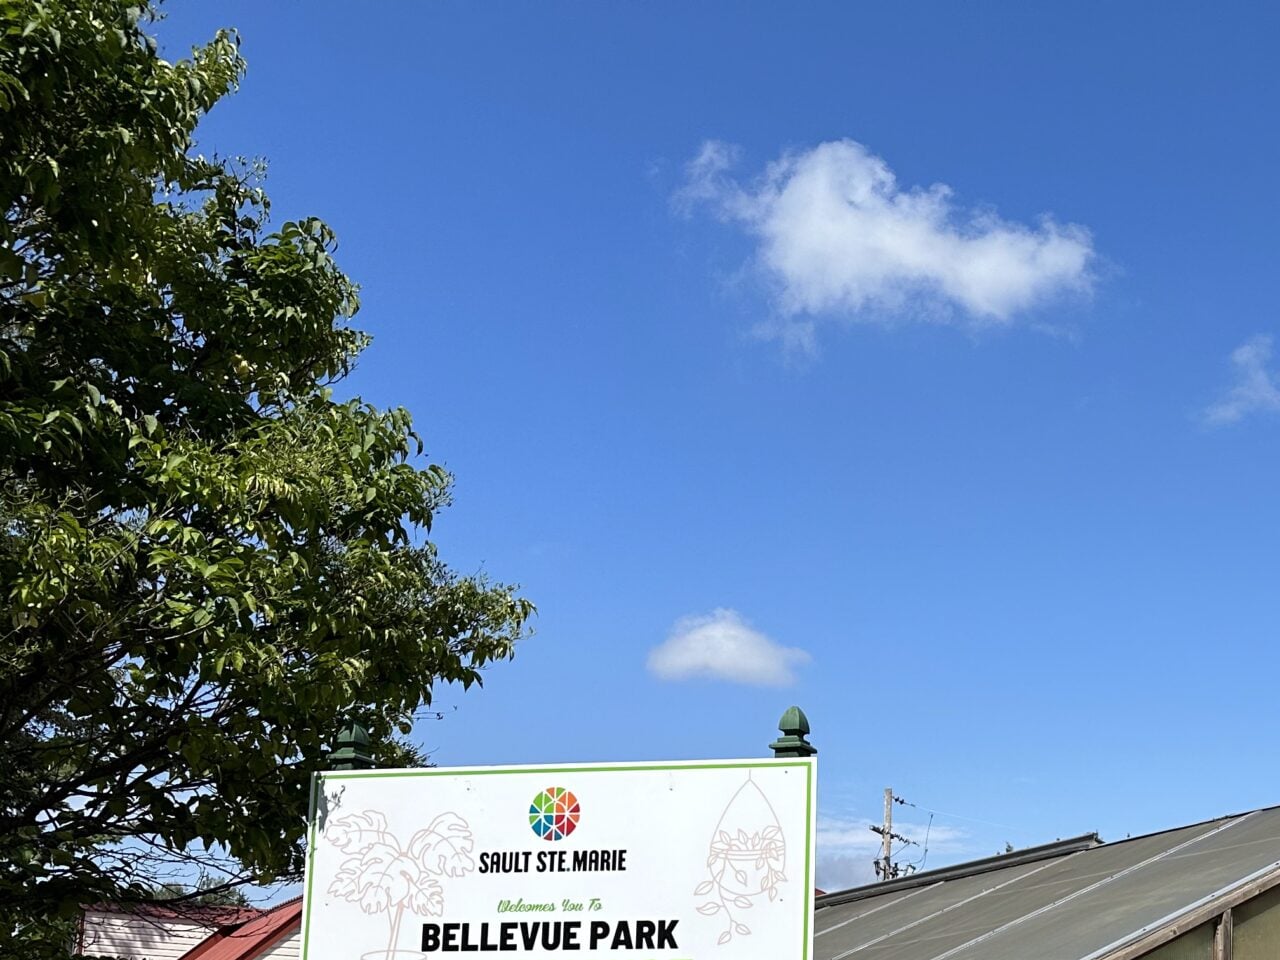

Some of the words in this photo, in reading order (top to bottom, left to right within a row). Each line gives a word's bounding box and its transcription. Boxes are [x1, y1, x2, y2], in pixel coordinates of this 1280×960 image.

[479, 851, 532, 874] SAULT
[572, 850, 627, 872] MARIE
[497, 898, 556, 913] Welcomes
[561, 898, 584, 912] You
[588, 898, 603, 912] To
[421, 921, 581, 952] BELLEVUE
[589, 920, 679, 950] PARK
